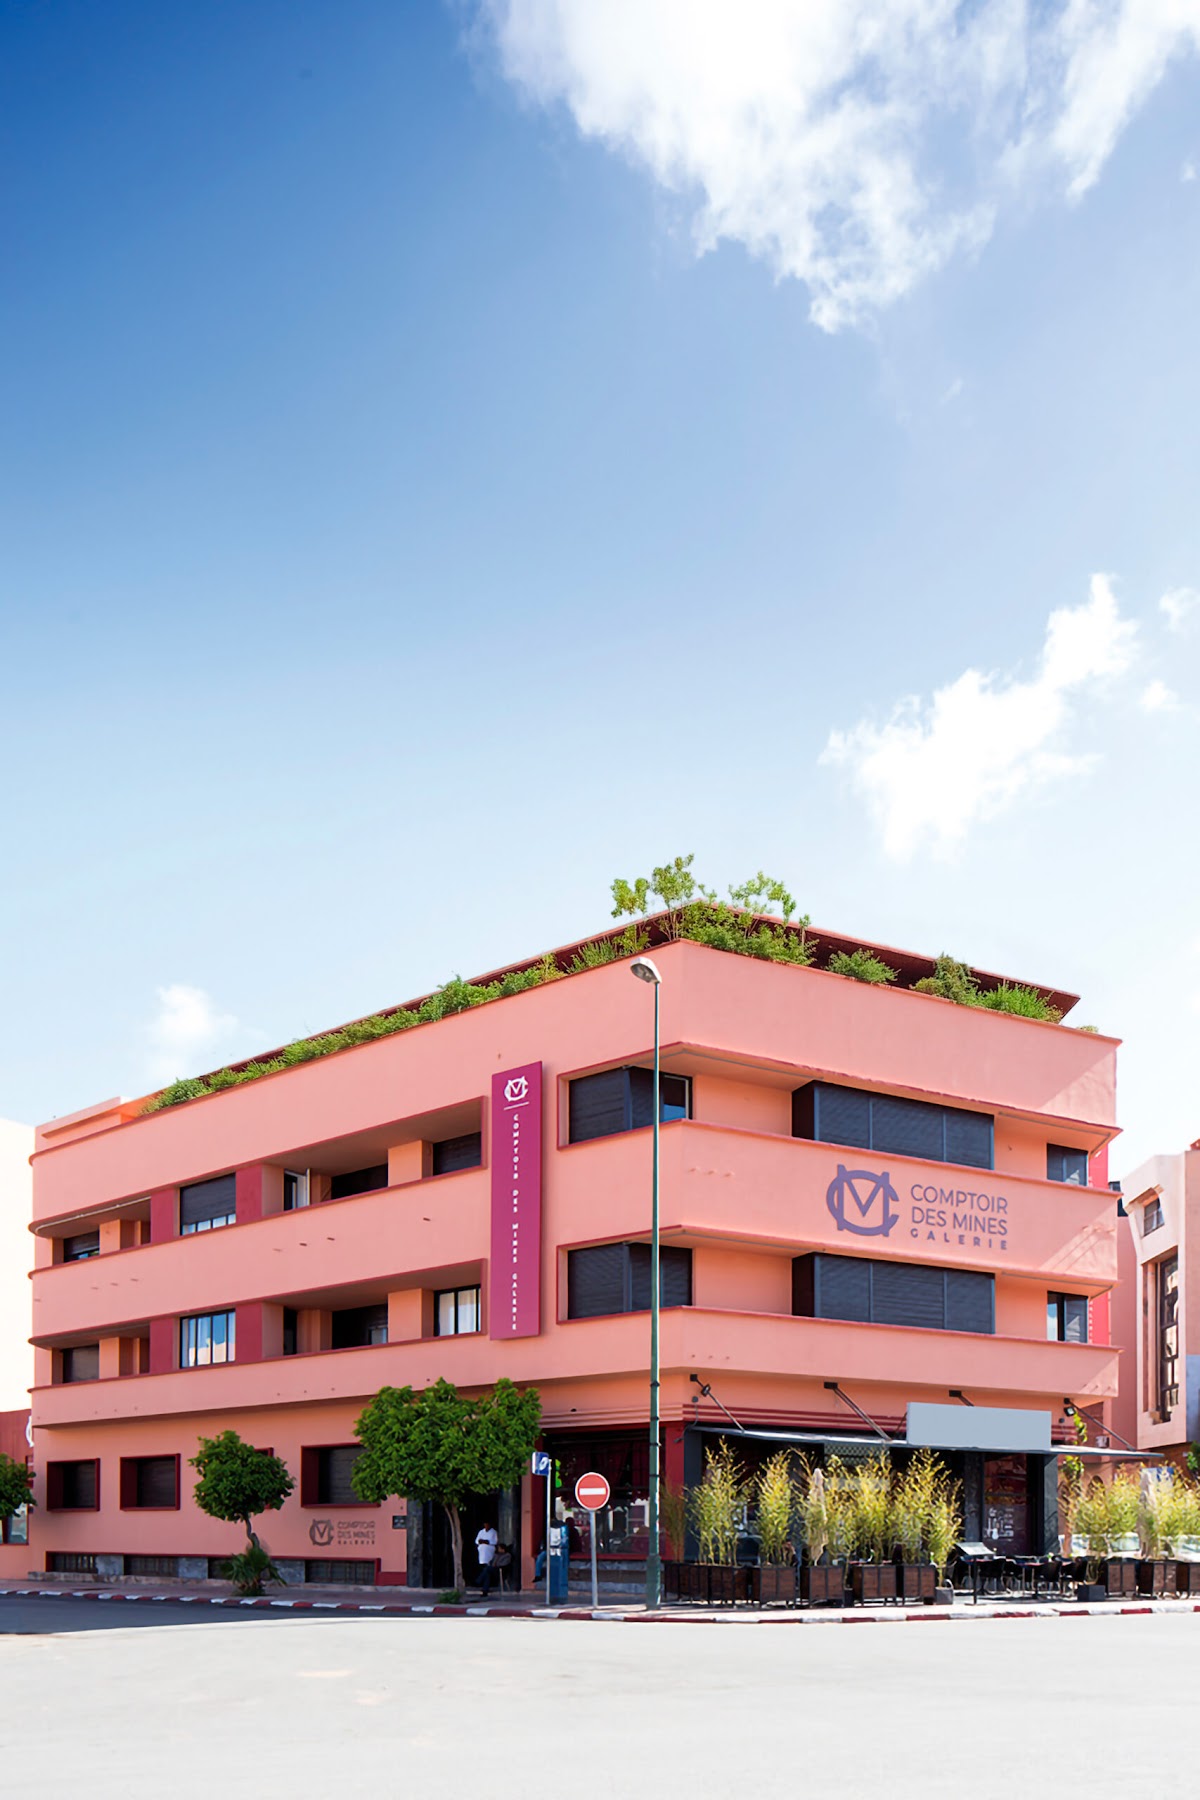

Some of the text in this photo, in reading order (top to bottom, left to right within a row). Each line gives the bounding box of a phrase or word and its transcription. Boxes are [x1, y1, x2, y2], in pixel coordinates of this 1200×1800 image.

[910, 1184, 1008, 1215] COMPTOIR
[911, 1206, 1008, 1236] DES MINES
[910, 1228, 1007, 1250] GALERIE
